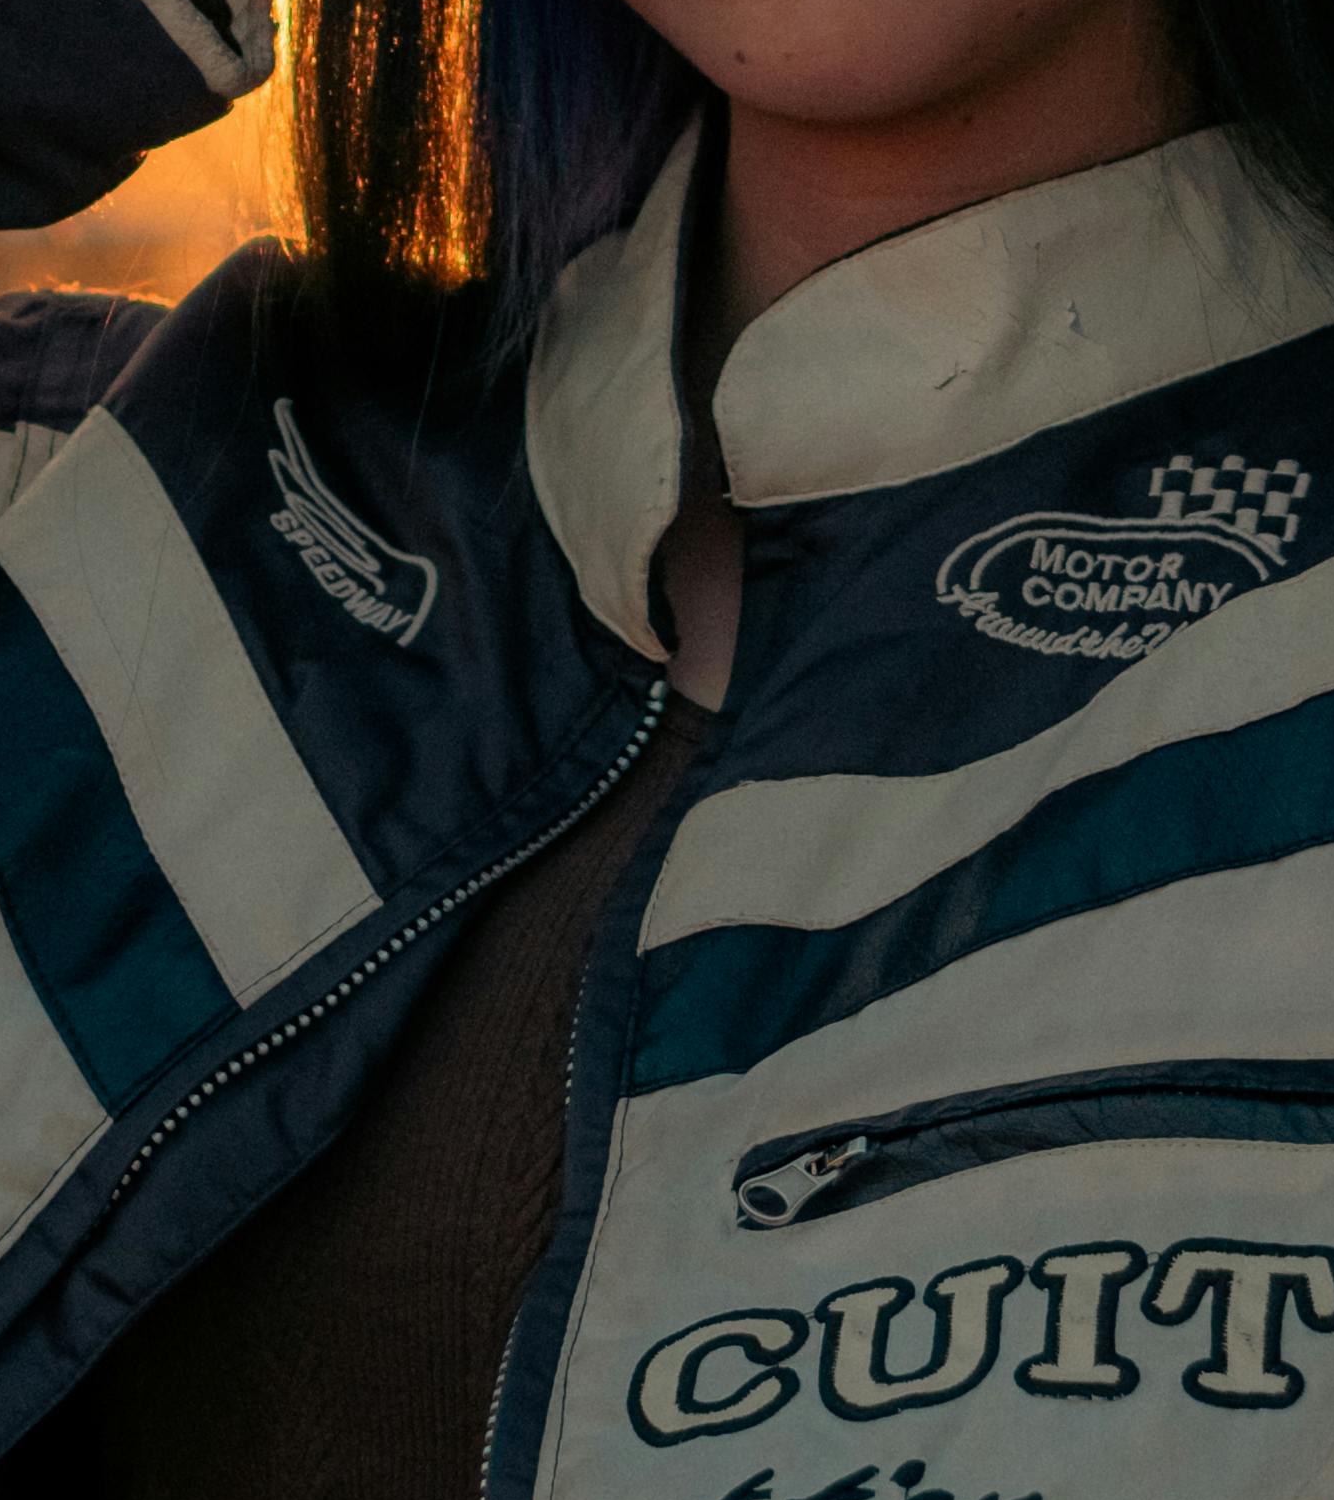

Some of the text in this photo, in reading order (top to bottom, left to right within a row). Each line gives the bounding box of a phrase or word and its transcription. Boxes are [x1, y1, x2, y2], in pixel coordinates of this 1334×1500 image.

[268, 508, 414, 633] SPEEDWAY
[1029, 537, 1185, 583] MOTOR
[1021, 573, 1235, 614] COMPANY
